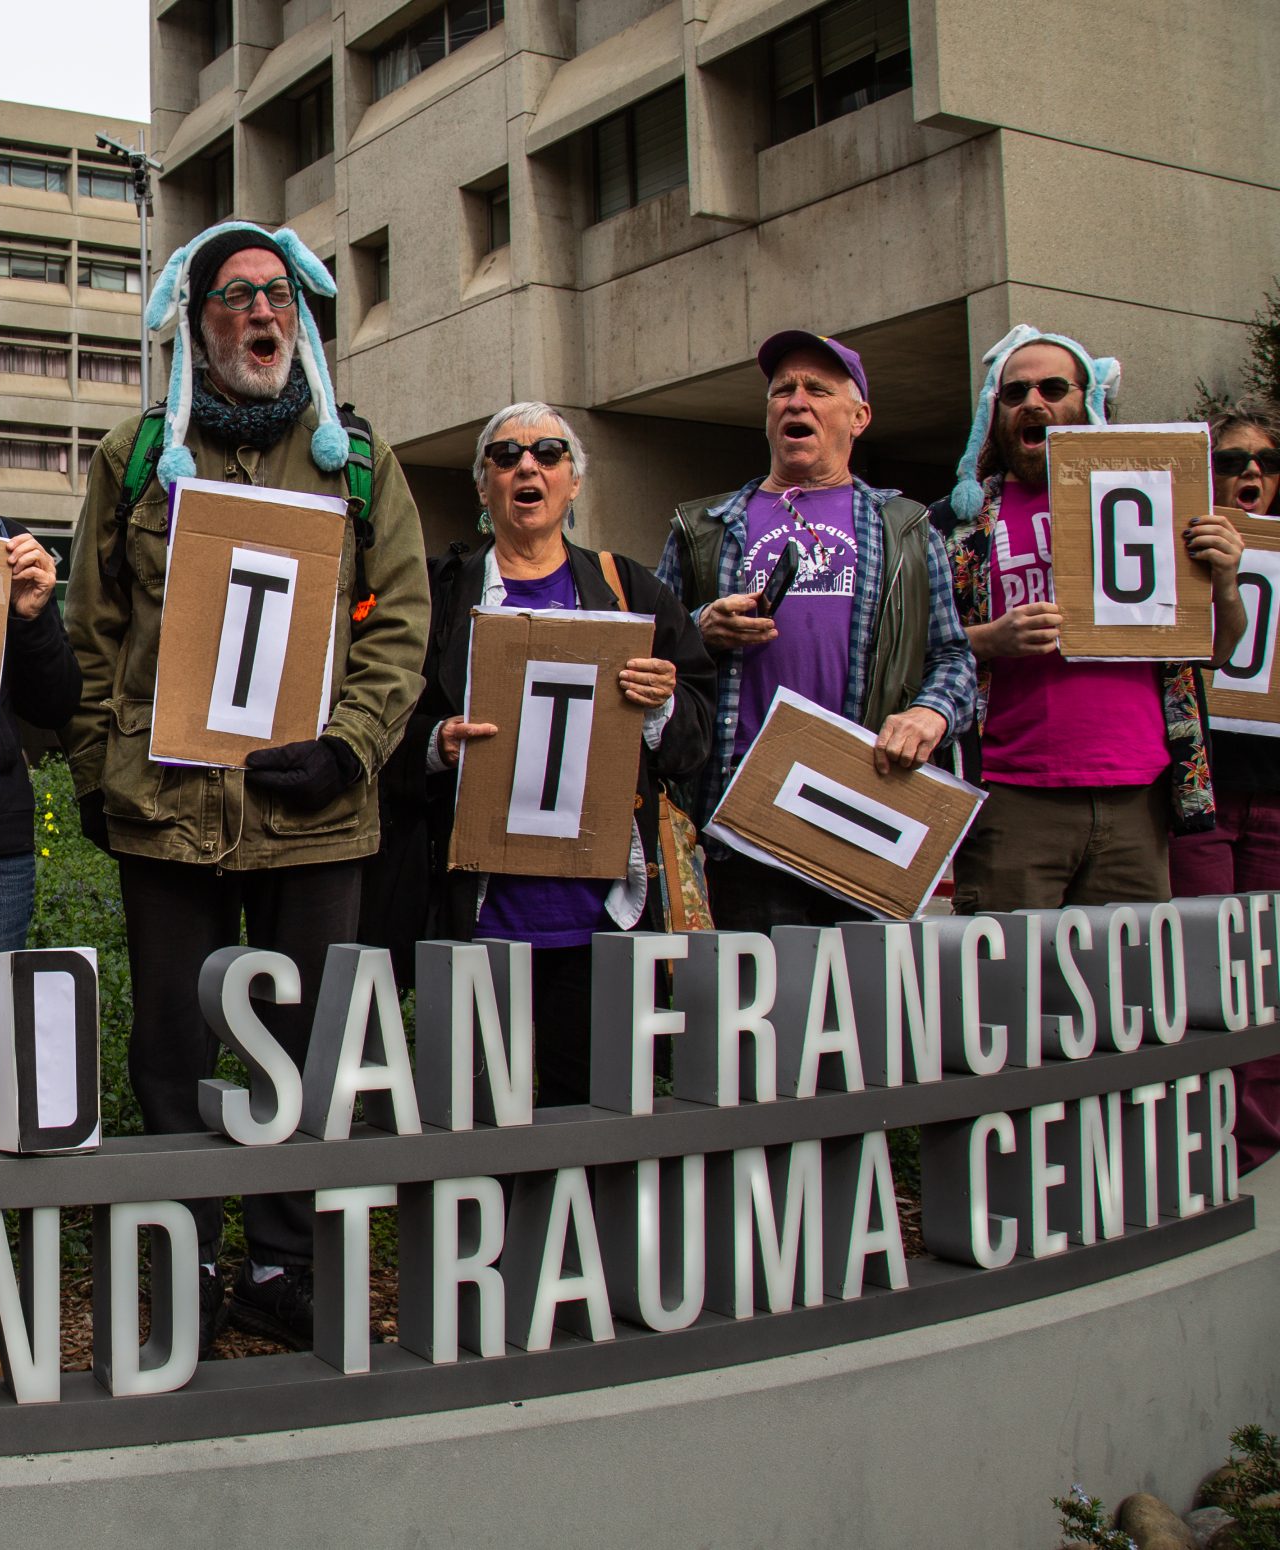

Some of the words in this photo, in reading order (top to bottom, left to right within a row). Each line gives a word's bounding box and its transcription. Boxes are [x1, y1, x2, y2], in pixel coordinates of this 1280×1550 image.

[1100, 487, 1156, 604] G
[230, 567, 289, 709] T
[530, 680, 594, 812] T
[220, 942, 533, 1146] SAN
[631, 901, 1188, 1116] FRANCISCO
[1218, 893, 1280, 1031] GE
[314, 1130, 910, 1375] TRAUMA
[969, 1067, 1239, 1270] CENTER
